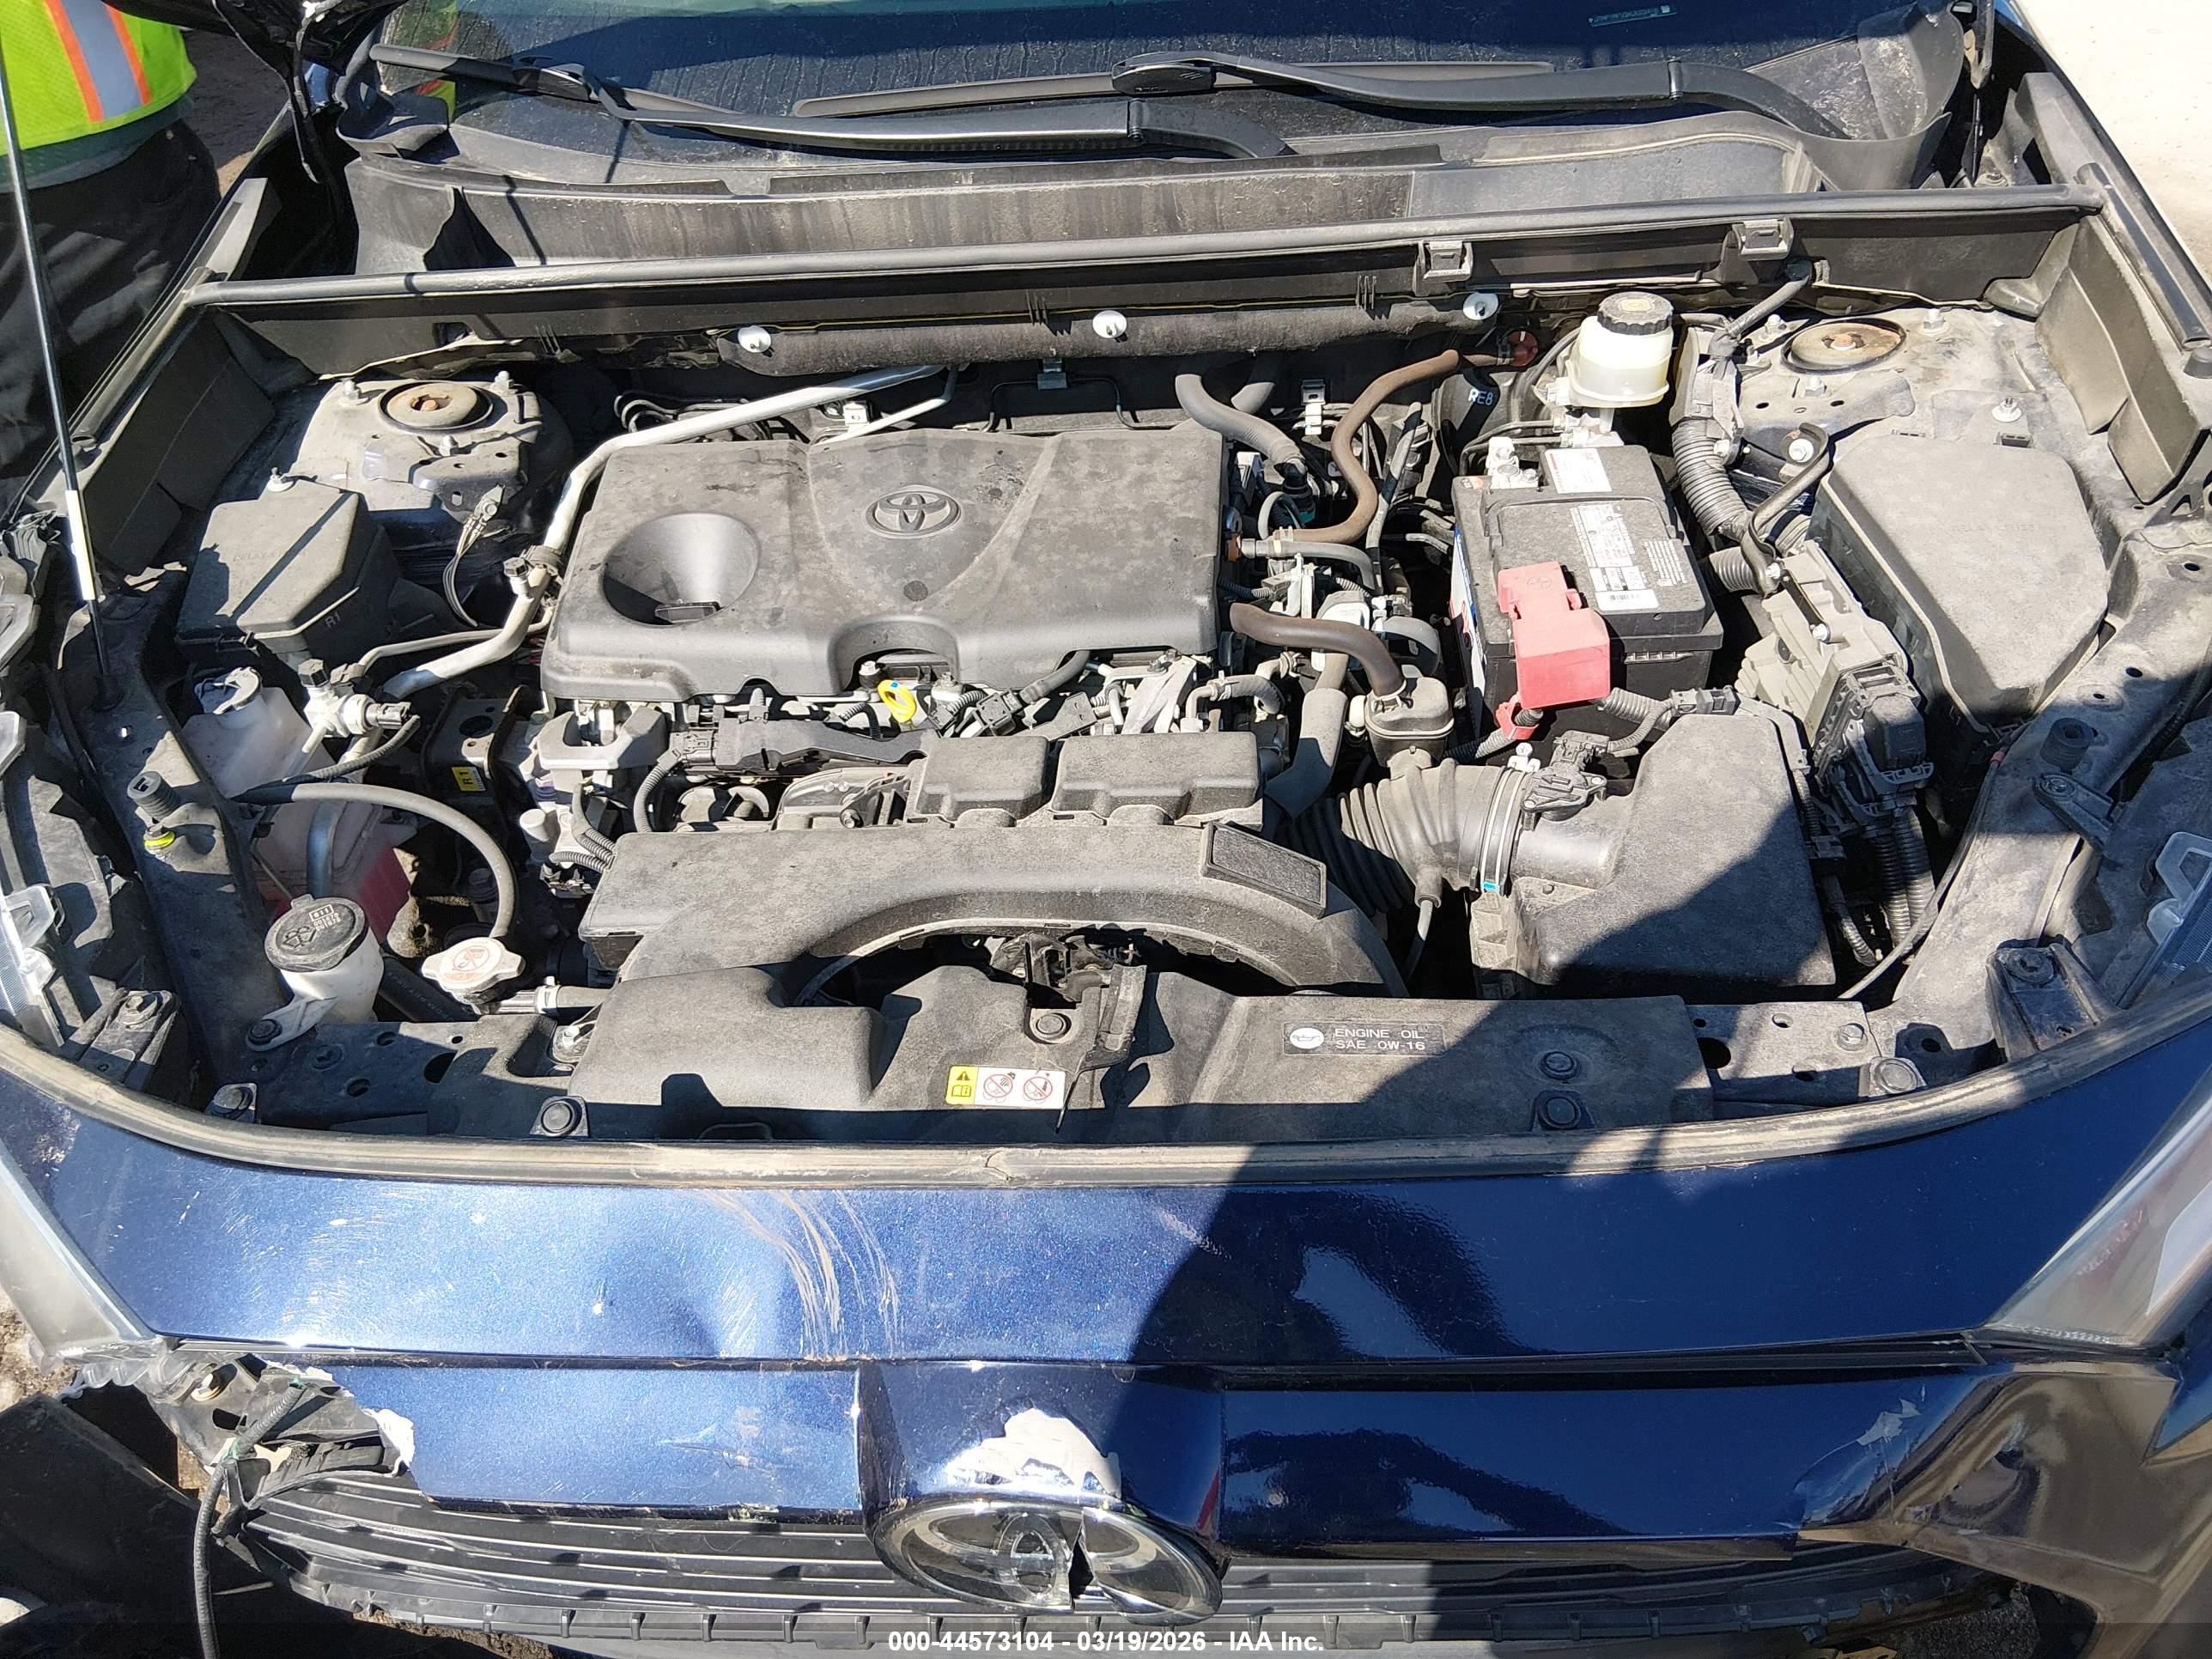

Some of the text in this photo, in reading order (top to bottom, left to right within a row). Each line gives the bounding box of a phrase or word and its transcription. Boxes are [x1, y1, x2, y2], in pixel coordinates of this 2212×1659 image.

[1468, 389, 1493, 405] RE8
[325, 611, 341, 628] R1
[459, 771, 474, 785] R1
[1334, 1028, 1425, 1039] ENGINE OIL
[1335, 1040, 1426, 1050] SAE 0W-16
